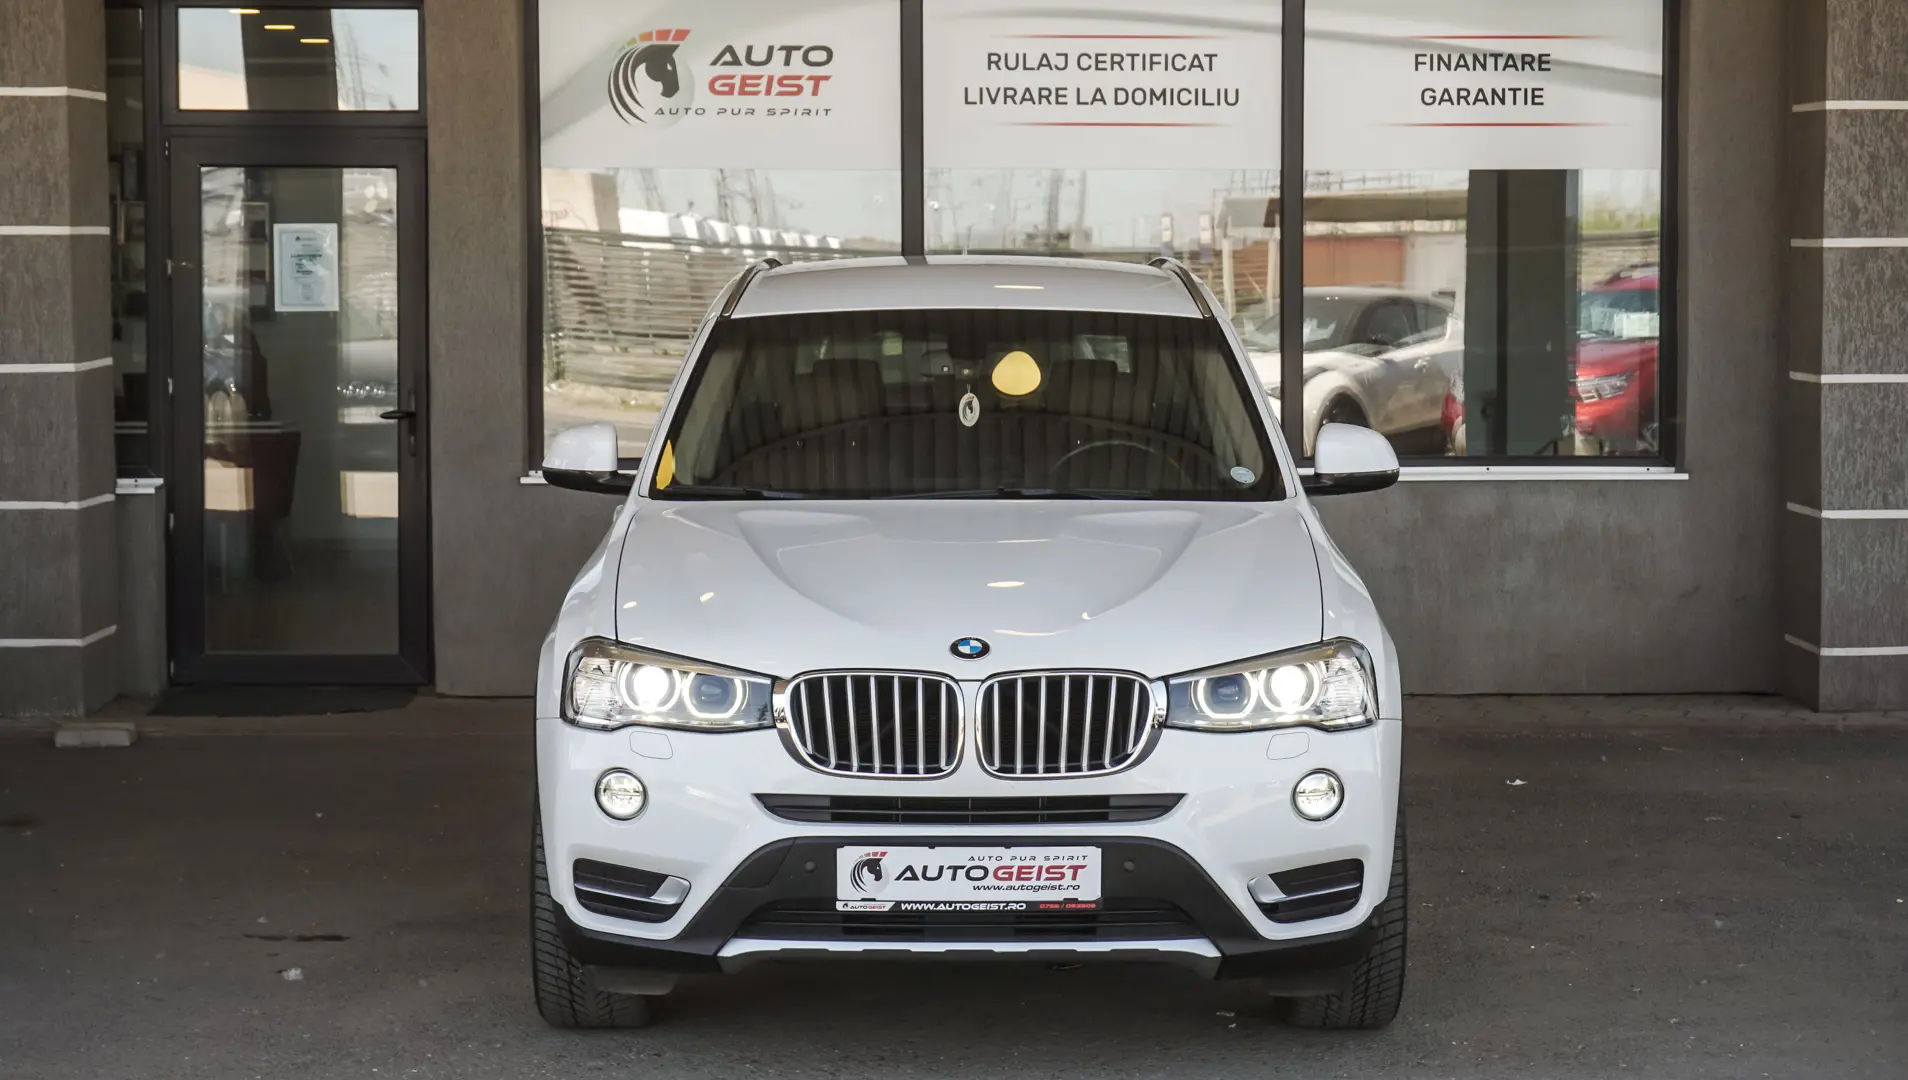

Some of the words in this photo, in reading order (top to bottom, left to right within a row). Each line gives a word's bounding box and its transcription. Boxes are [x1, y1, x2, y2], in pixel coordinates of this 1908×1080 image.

[709, 44, 834, 67] AUTO
[987, 52, 1069, 71] RULAJ
[1076, 53, 1218, 72] CERTIFICAT
[1414, 53, 1552, 72] FINANTARE
[708, 74, 833, 97] GEIST
[964, 87, 1068, 105] LIVRARE
[1076, 88, 1107, 105] LA
[1114, 88, 1240, 106] DOMICILIU
[1420, 87, 1545, 106] GARANTIE
[654, 107, 706, 116] AUTO
[716, 107, 756, 116] PUR
[766, 107, 833, 117] SPIRIT
[972, 883, 1081, 893] www.autogeist.ro
[901, 902, 1027, 911] WWW.AUTOGEIST.RO
